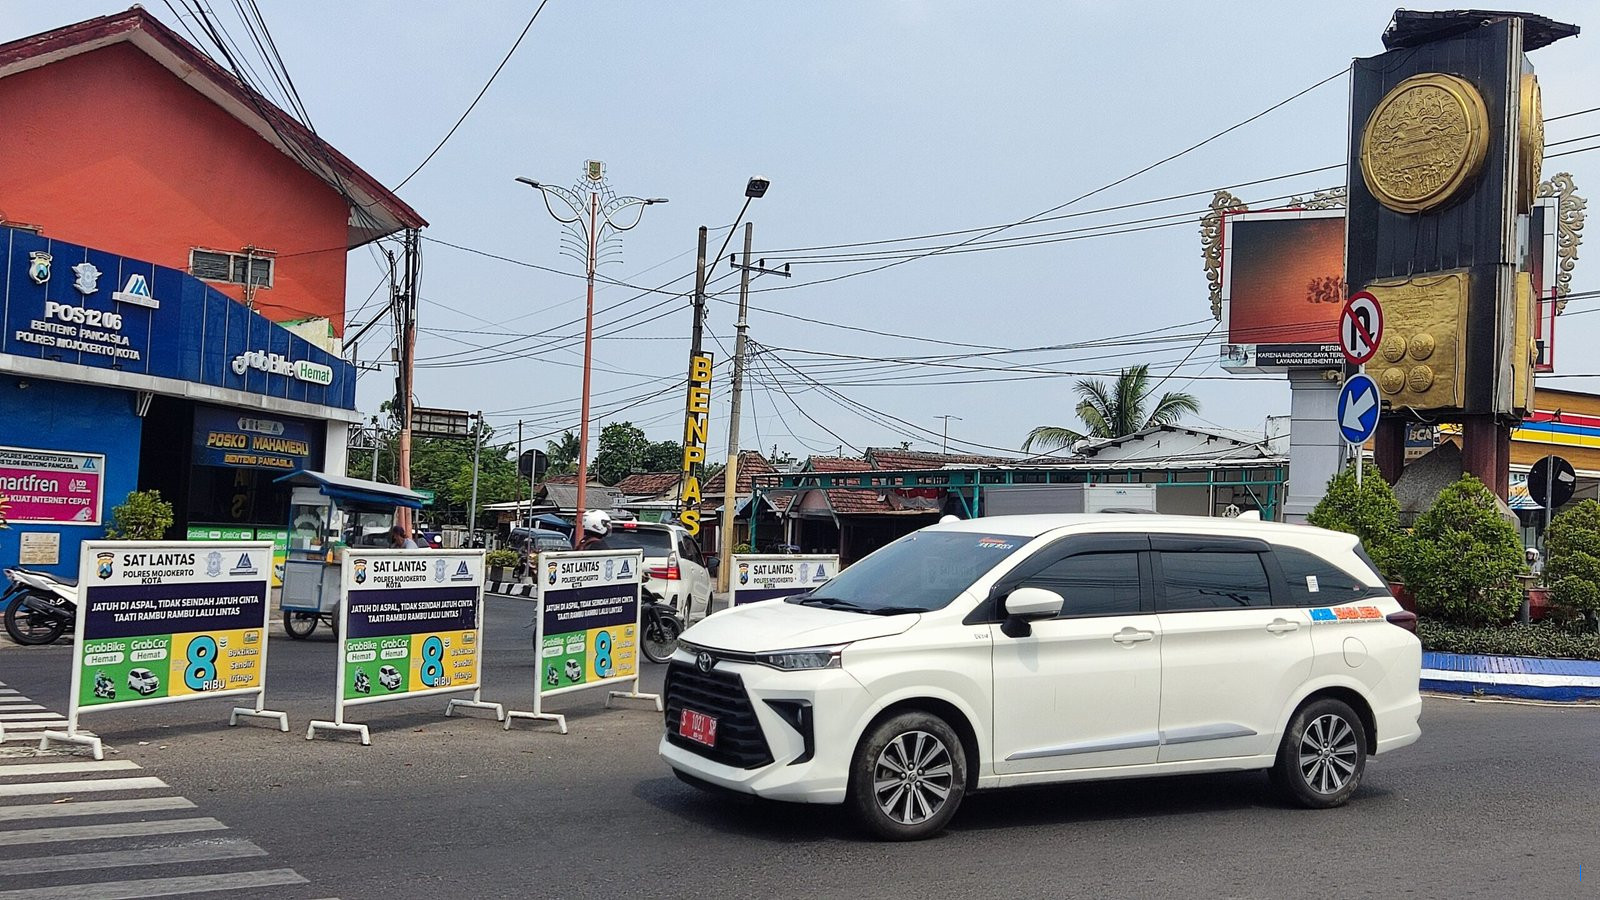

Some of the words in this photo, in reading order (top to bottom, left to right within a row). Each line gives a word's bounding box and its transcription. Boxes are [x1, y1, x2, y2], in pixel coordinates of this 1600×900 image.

[31, 320, 76, 336] BENTENG
[80, 328, 130, 346] PANCASILA
[16, 330, 55, 346] POLRES
[56, 338, 114, 355] MOJOKERTO
[116, 348, 140, 360] KOTA
[300, 363, 330, 382] Hemat
[207, 432, 246, 448] POSKO
[252, 436, 309, 456] MAHAMERU
[22, 454, 57, 462] MOJOKERTO
[224, 454, 256, 464] BENTENG
[258, 456, 294, 468] PANCASILA
[10, 494, 31, 502] KUAT
[32, 496, 68, 504] INTERNET
[68, 497, 91, 505] CEPAT
[123, 554, 147, 567] SAT
[150, 553, 195, 566] LANTAS
[373, 561, 390, 572] SAT
[393, 561, 427, 572] LANTAS
[152, 569, 194, 577] MOJOKERTO
[562, 562, 574, 574] SAT
[575, 561, 600, 572] LANTAS
[754, 565, 766, 574] SAT
[768, 564, 794, 574] LANTAS
[92, 602, 119, 612] JATUH
[120, 602, 130, 610] DI
[130, 601, 158, 610] ASPAL,
[158, 600, 181, 608] TIDAK
[182, 598, 215, 607] SEINDAH
[215, 597, 238, 606] JATUH
[239, 596, 259, 604] CINTA
[351, 604, 372, 613] JATUH
[372, 604, 379, 612] DI
[380, 604, 400, 612] ASPAL,
[400, 602, 417, 610] TIDAK
[418, 601, 440, 609] SEINDAH
[441, 600, 457, 608] JATUH
[114, 613, 136, 622] TAATI
[138, 612, 165, 620] RAMBU
[167, 610, 195, 619] RAMBU
[196, 609, 215, 617] LALU
[215, 607, 240, 616] LINTAS
[368, 614, 385, 623] TAATI
[386, 613, 406, 622] RAMBU
[408, 612, 427, 620] RAMBU
[441, 610, 458, 618] LINTAS
[85, 642, 126, 654] GrabBike
[131, 639, 168, 650] GrabCar
[347, 642, 378, 651] GrabBike
[381, 639, 409, 648] GrabCar
[92, 655, 117, 663] Hemat
[137, 652, 160, 660] Hemat
[594, 630, 612, 678] 8
[184, 635, 218, 692] 8
[420, 636, 444, 687] 8
[203, 680, 226, 690] RIBU
[434, 677, 451, 686] RIBU
